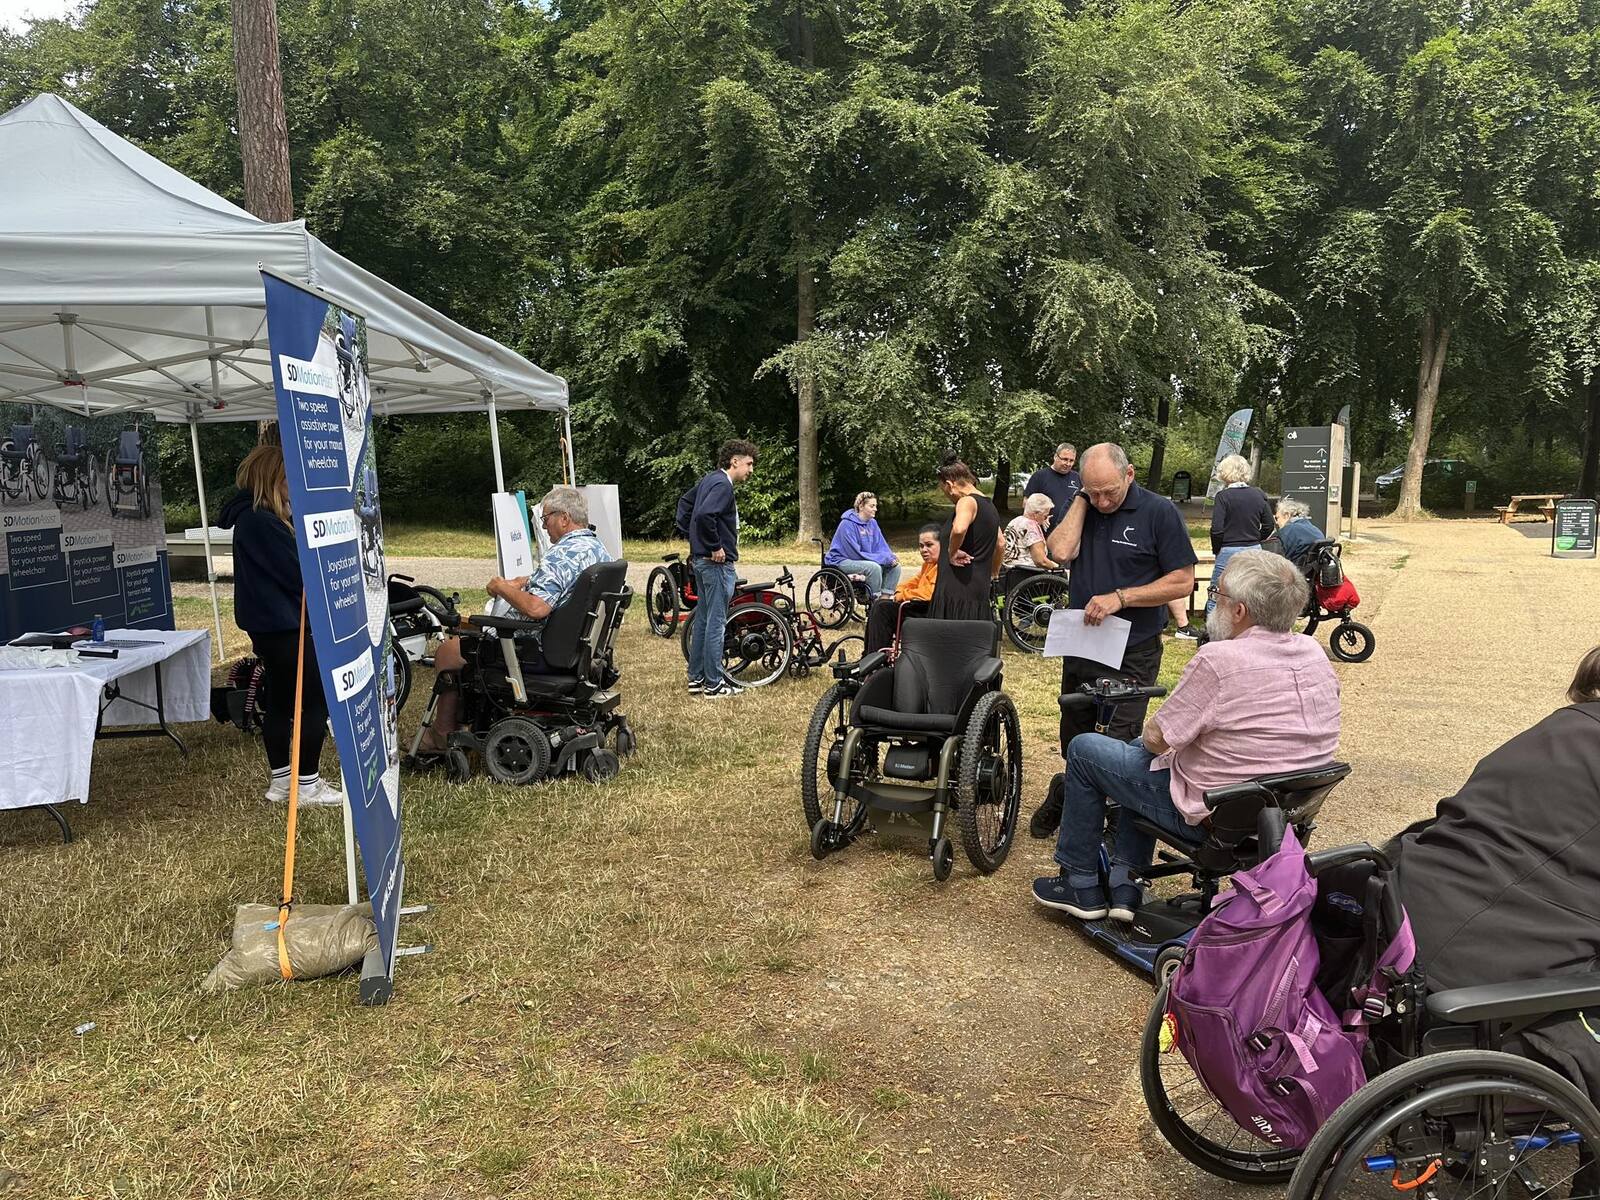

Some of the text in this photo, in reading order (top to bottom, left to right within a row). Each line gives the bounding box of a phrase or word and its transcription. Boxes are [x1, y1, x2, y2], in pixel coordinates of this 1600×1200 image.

[296, 397, 328, 415] Two speed
[301, 418, 327, 432] assistive
[303, 436, 312, 449] for
[313, 440, 328, 454] your
[10, 533, 41, 544] Two speed
[37, 543, 56, 554] power
[11, 553, 59, 567] for your manual
[13, 566, 46, 577] wheelchair
[330, 578, 340, 592] for
[341, 577, 351, 592] your
